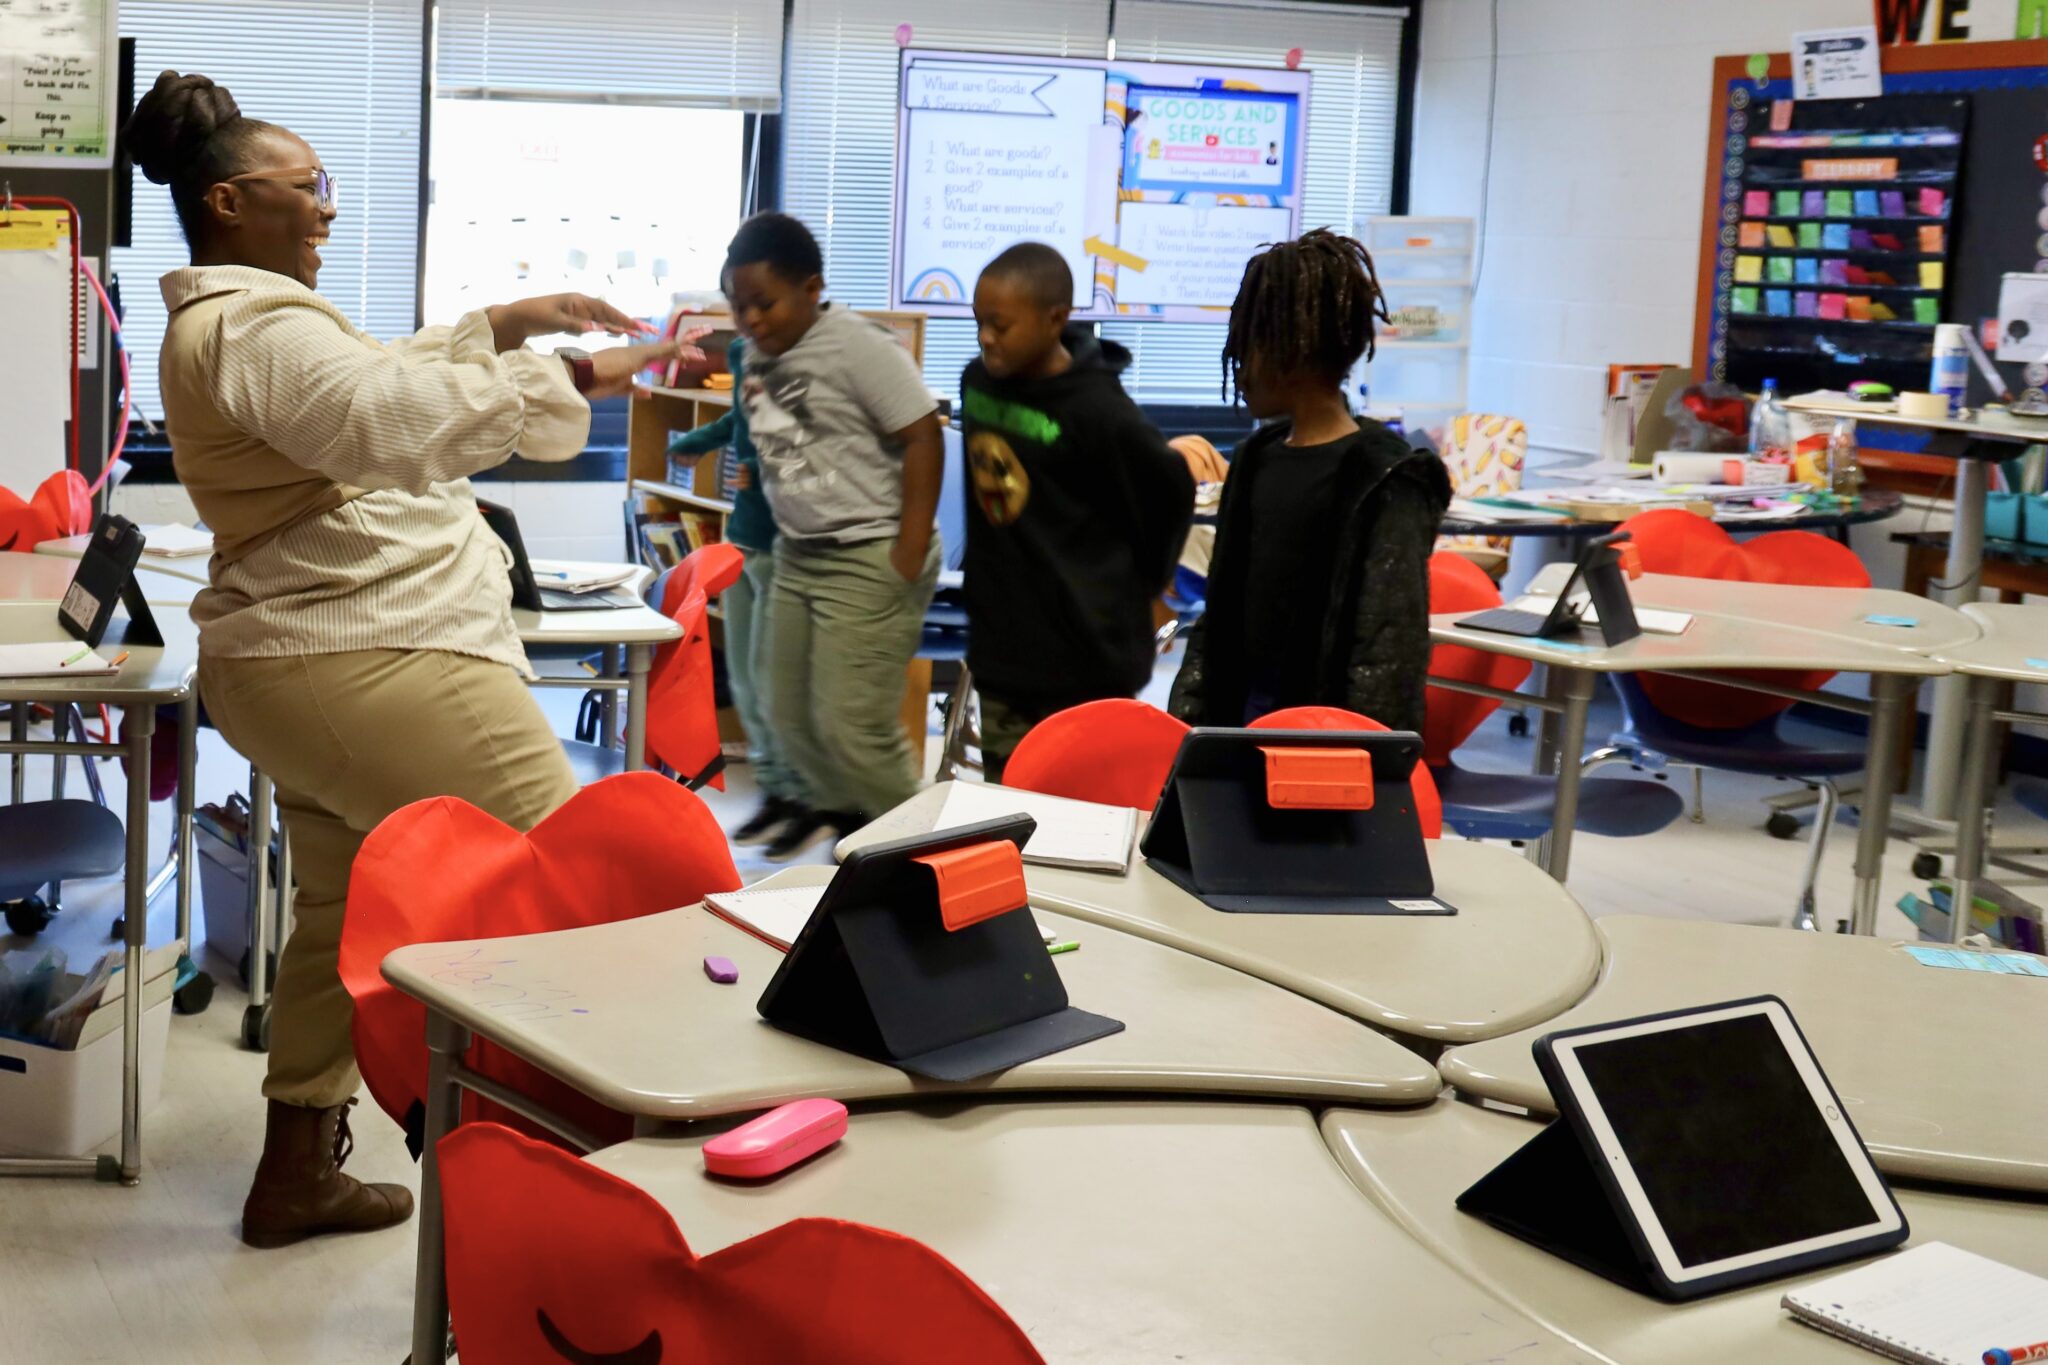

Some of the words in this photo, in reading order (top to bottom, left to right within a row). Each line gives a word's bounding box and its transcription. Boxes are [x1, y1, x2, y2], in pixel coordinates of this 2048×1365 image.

[60, 81, 74, 89] and
[922, 75, 959, 91] What
[963, 82, 983, 92] are
[986, 78, 1027, 95] Goods
[935, 95, 1001, 112] Services?
[1150, 98, 1227, 121] GOODS
[1234, 104, 1277, 124] AND
[35, 111, 56, 124] Keep
[41, 126, 64, 139] going
[947, 141, 981, 157] What
[985, 148, 1003, 157] are
[1008, 146, 1051, 161] goods?
[945, 160, 973, 175] Give
[977, 162, 985, 176] 2
[987, 164, 1043, 179] examples
[1047, 165, 1060, 179] of
[944, 180, 983, 196] good?
[944, 197, 977, 212] What
[982, 203, 1000, 213] are
[1004, 202, 1064, 217] services?
[943, 216, 970, 230] Give
[973, 217, 981, 231] 2
[984, 219, 1041, 235] examples
[1044, 220, 1057, 233] of
[942, 236, 996, 250] service?
